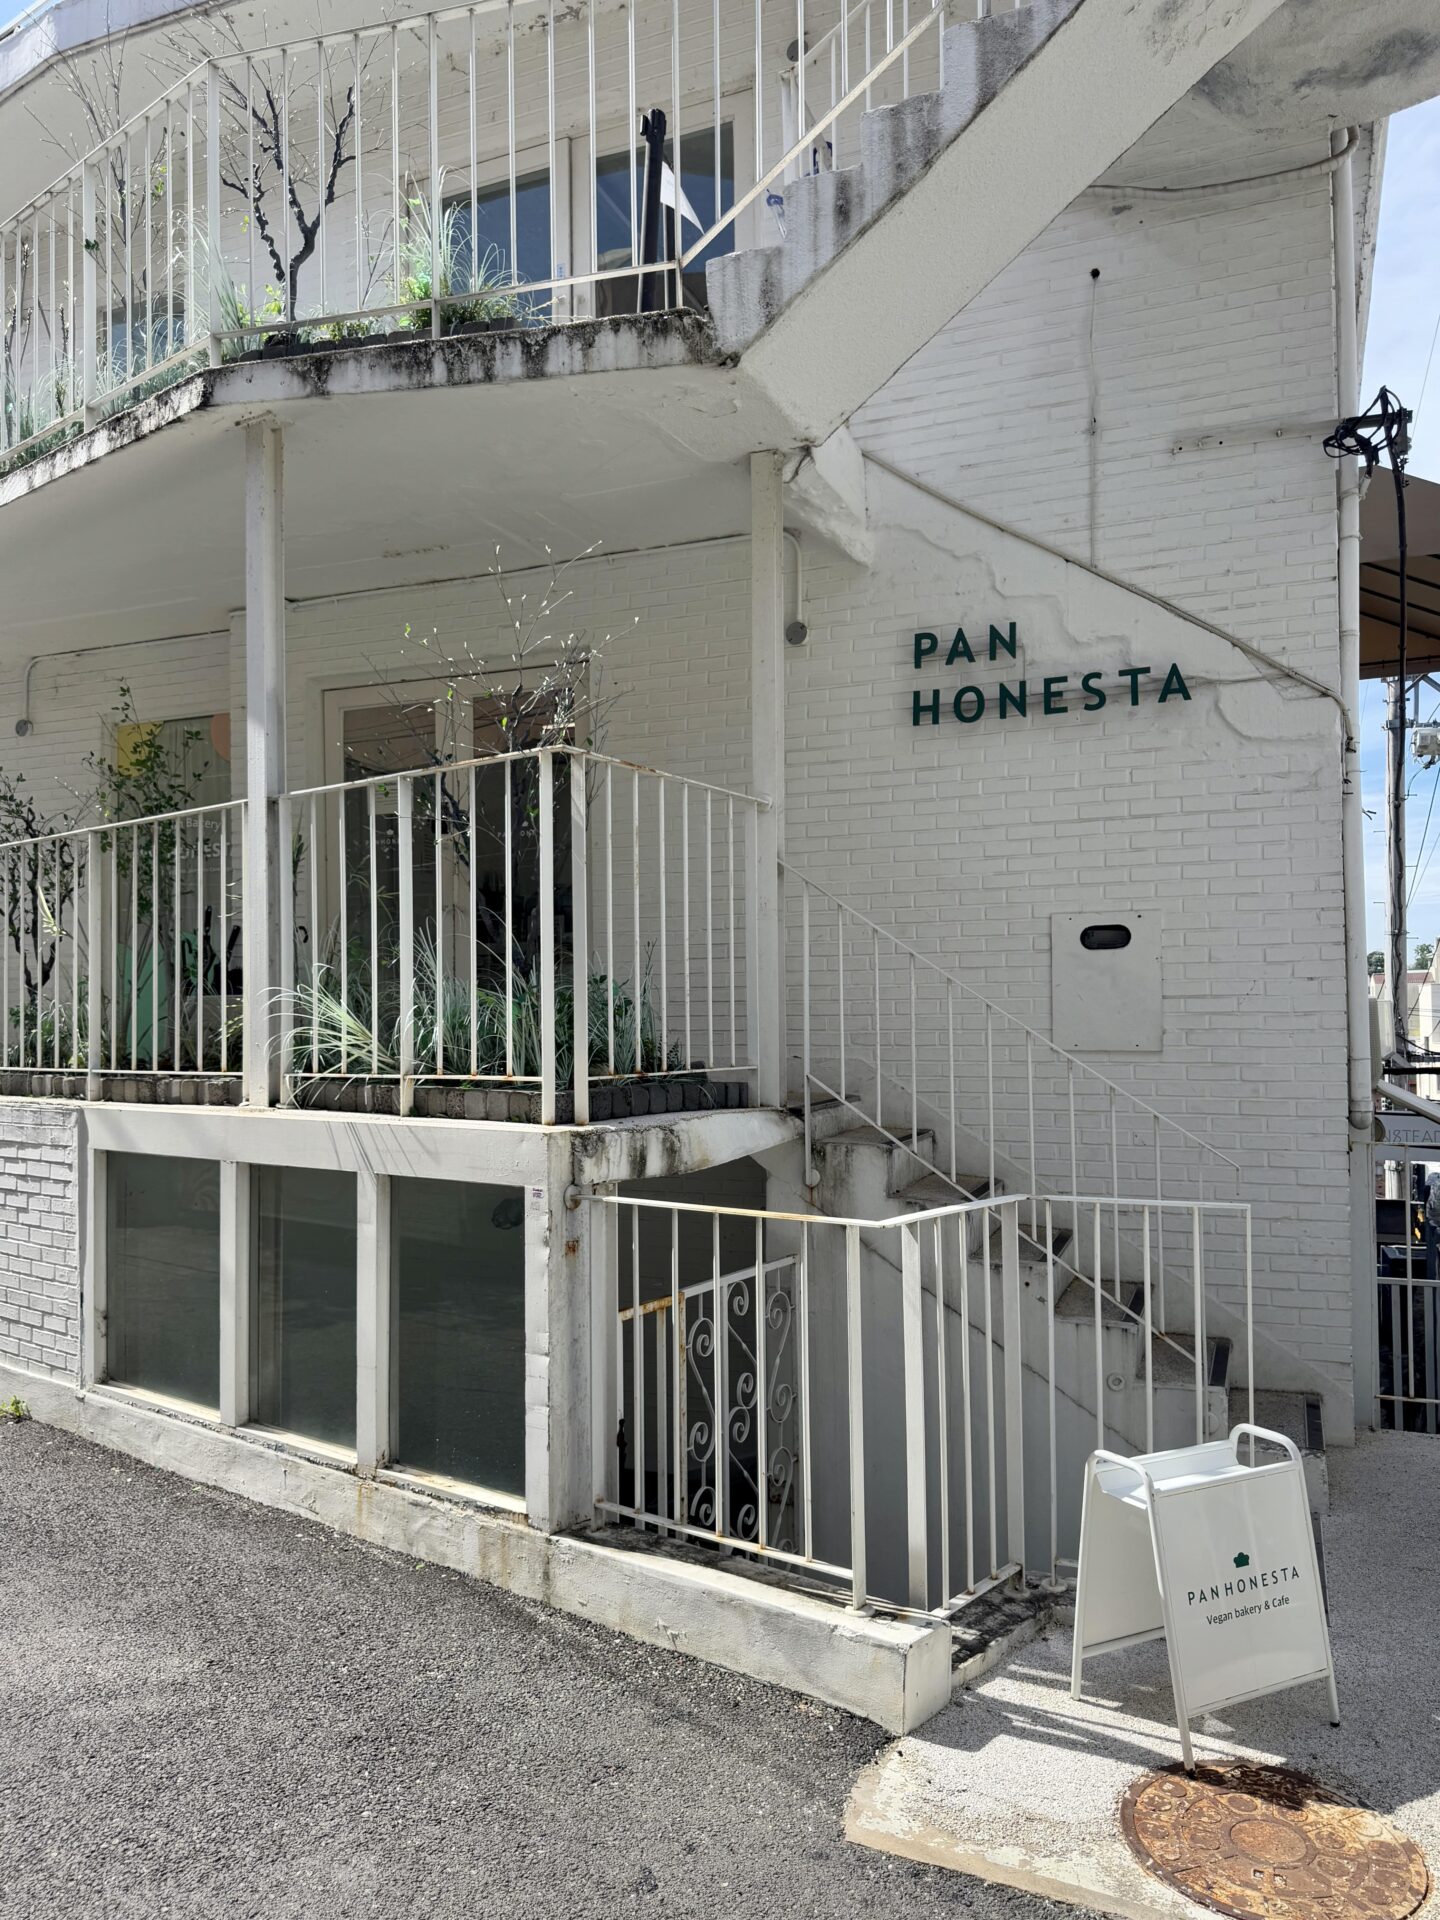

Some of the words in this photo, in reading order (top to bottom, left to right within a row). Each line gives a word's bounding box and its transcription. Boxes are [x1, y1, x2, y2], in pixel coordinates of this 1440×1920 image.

[913, 621, 1017, 669] PAN
[912, 662, 1192, 726] HONESTA
[186, 817, 221, 832] Baery
[1206, 1611, 1233, 1625] Vegan
[1234, 1604, 1262, 1619] bakery
[1264, 1600, 1270, 1610] &
[1272, 1595, 1290, 1608] Cafe
